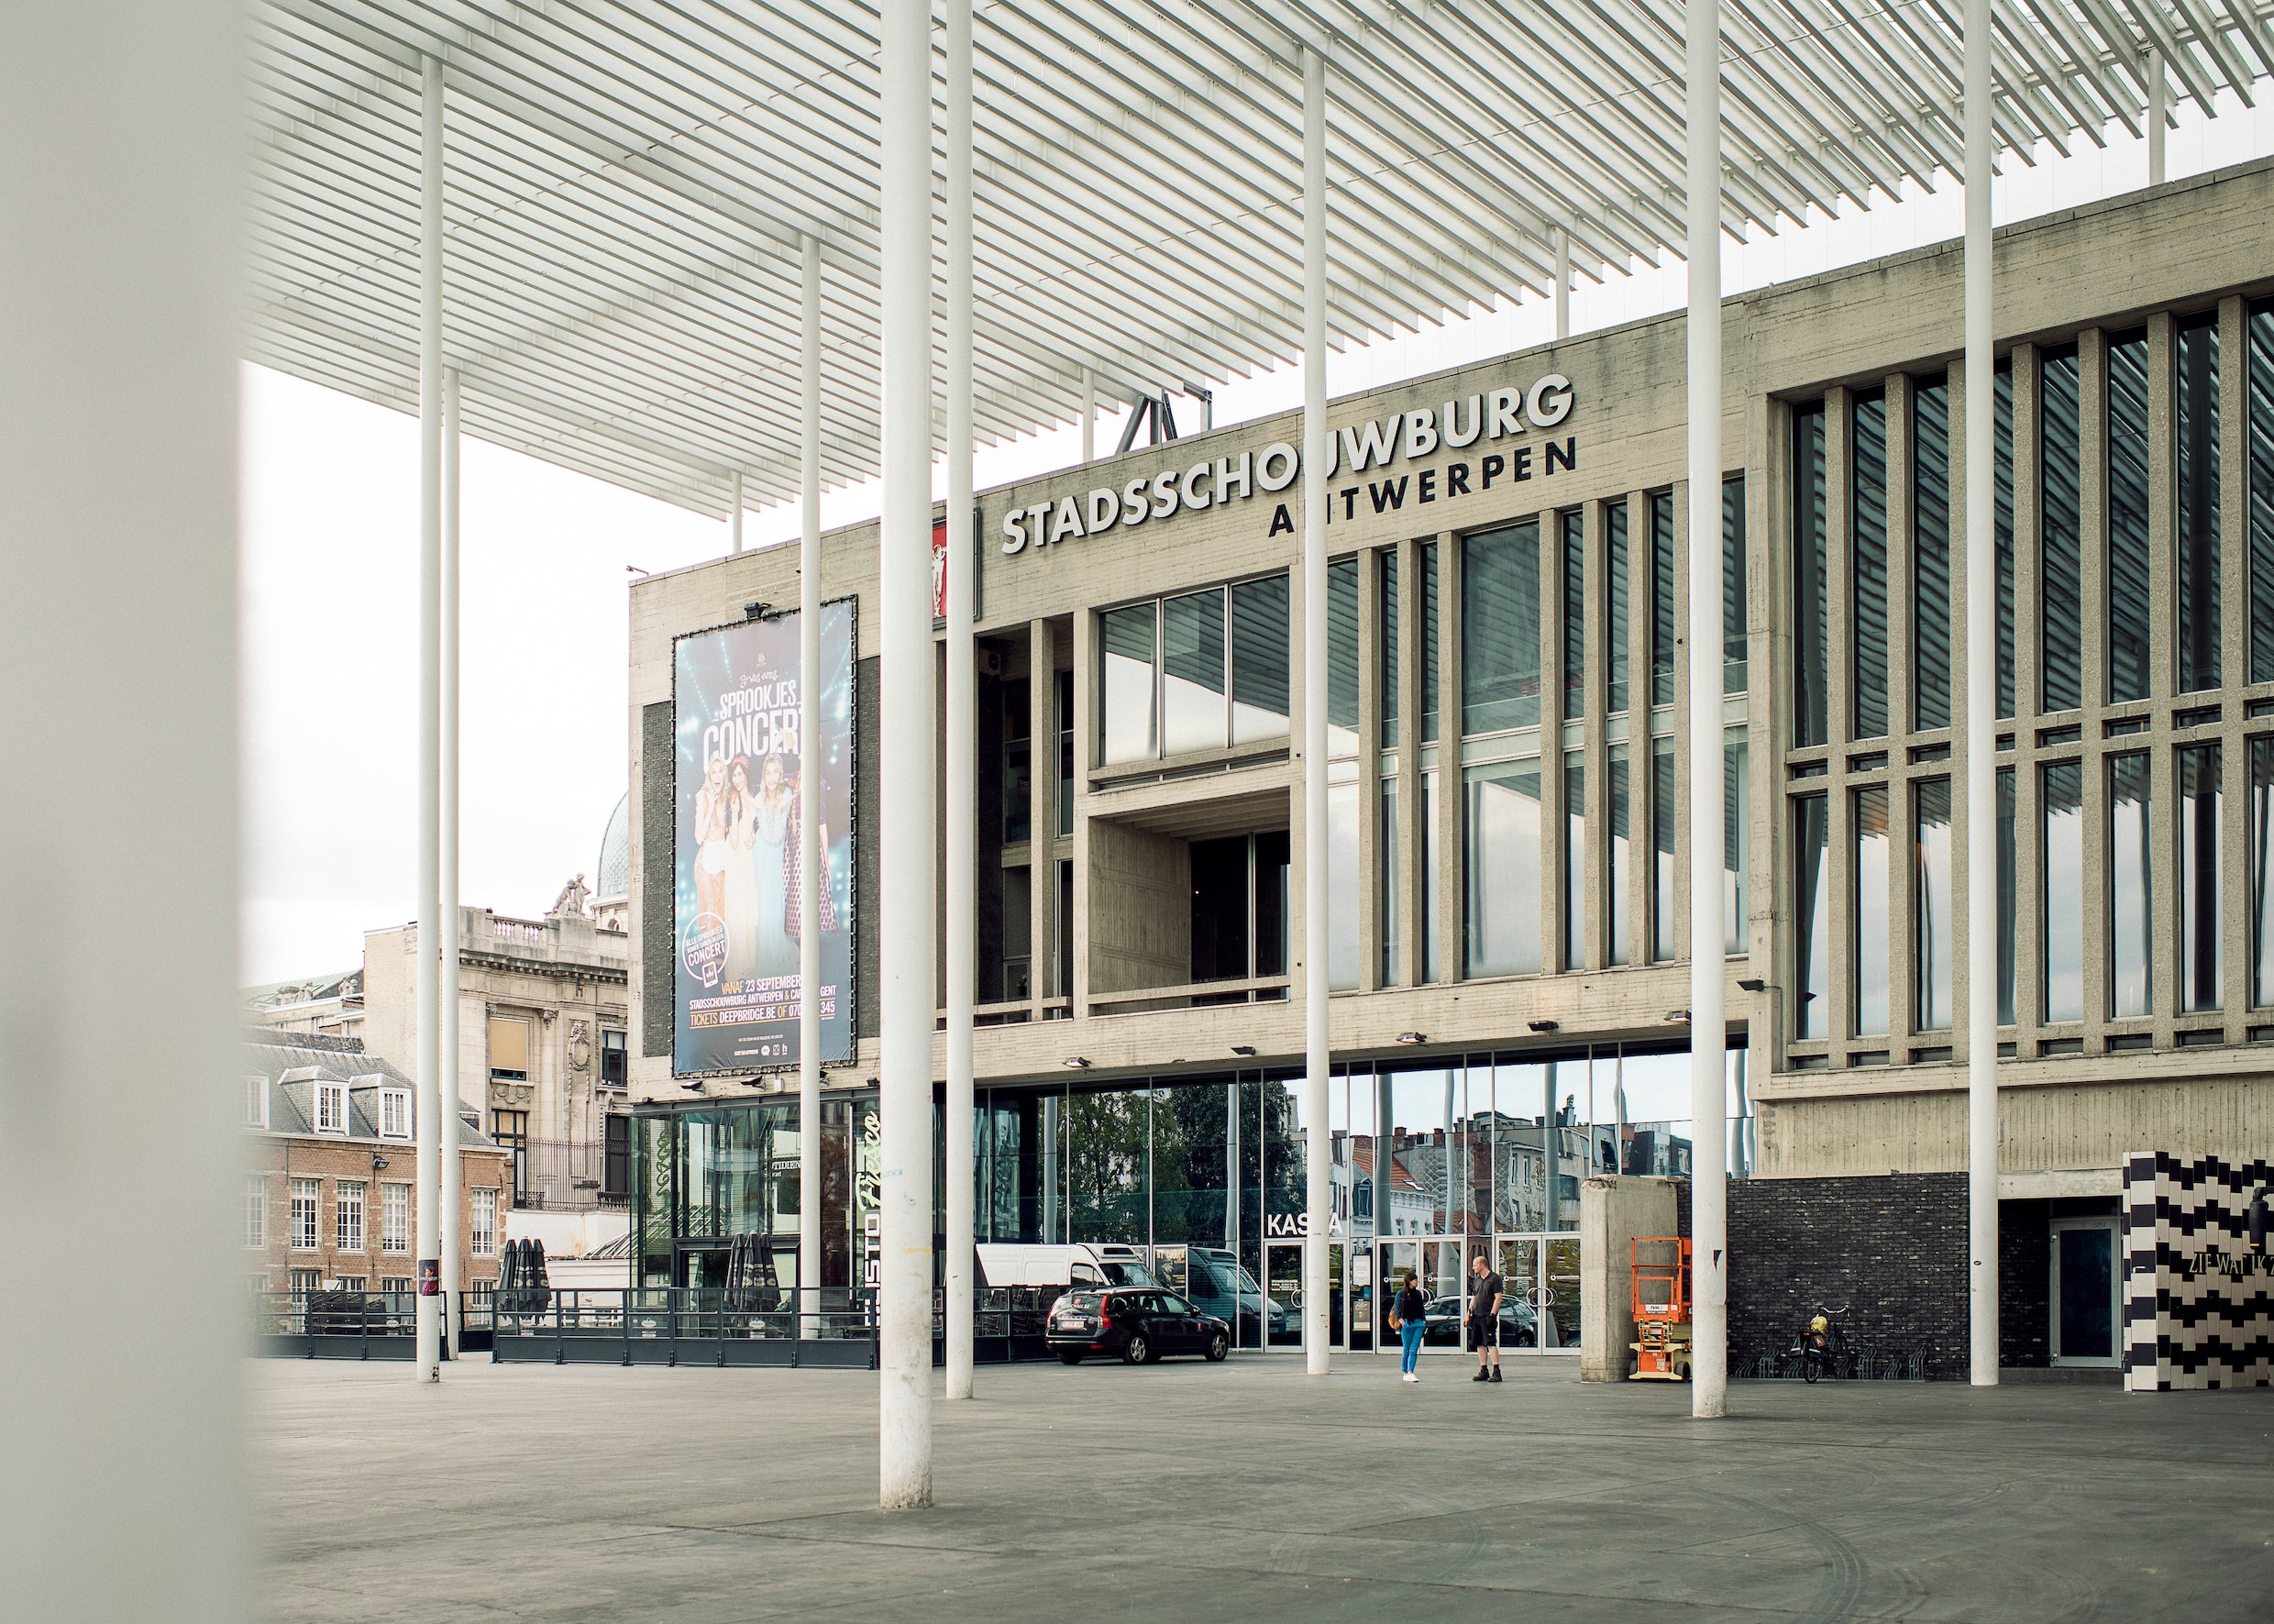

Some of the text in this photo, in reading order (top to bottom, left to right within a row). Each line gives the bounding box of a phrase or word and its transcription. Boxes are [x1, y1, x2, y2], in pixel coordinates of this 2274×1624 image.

[1268, 437, 1576, 537] ATWERPEN
[720, 679, 797, 721] SPROOKJES
[703, 709, 800, 775] CONCER
[688, 939, 724, 967] CONCERT
[690, 993, 746, 1010] STADSSCHOUWBURG
[747, 988, 784, 1003] ANTWERPEN
[784, 989, 789, 1000] &
[820, 985, 836, 997] GENT
[721, 974, 800, 995] VANAF 23 SEPTEMBER
[690, 1011, 718, 1027] TICKETS
[720, 1006, 776, 1024] DEEPBRIDGE.BE
[778, 1005, 787, 1018] OF
[821, 1000, 835, 1014] 345
[855, 1110, 880, 1211] Fresco
[1267, 1212, 1343, 1236] KASA
